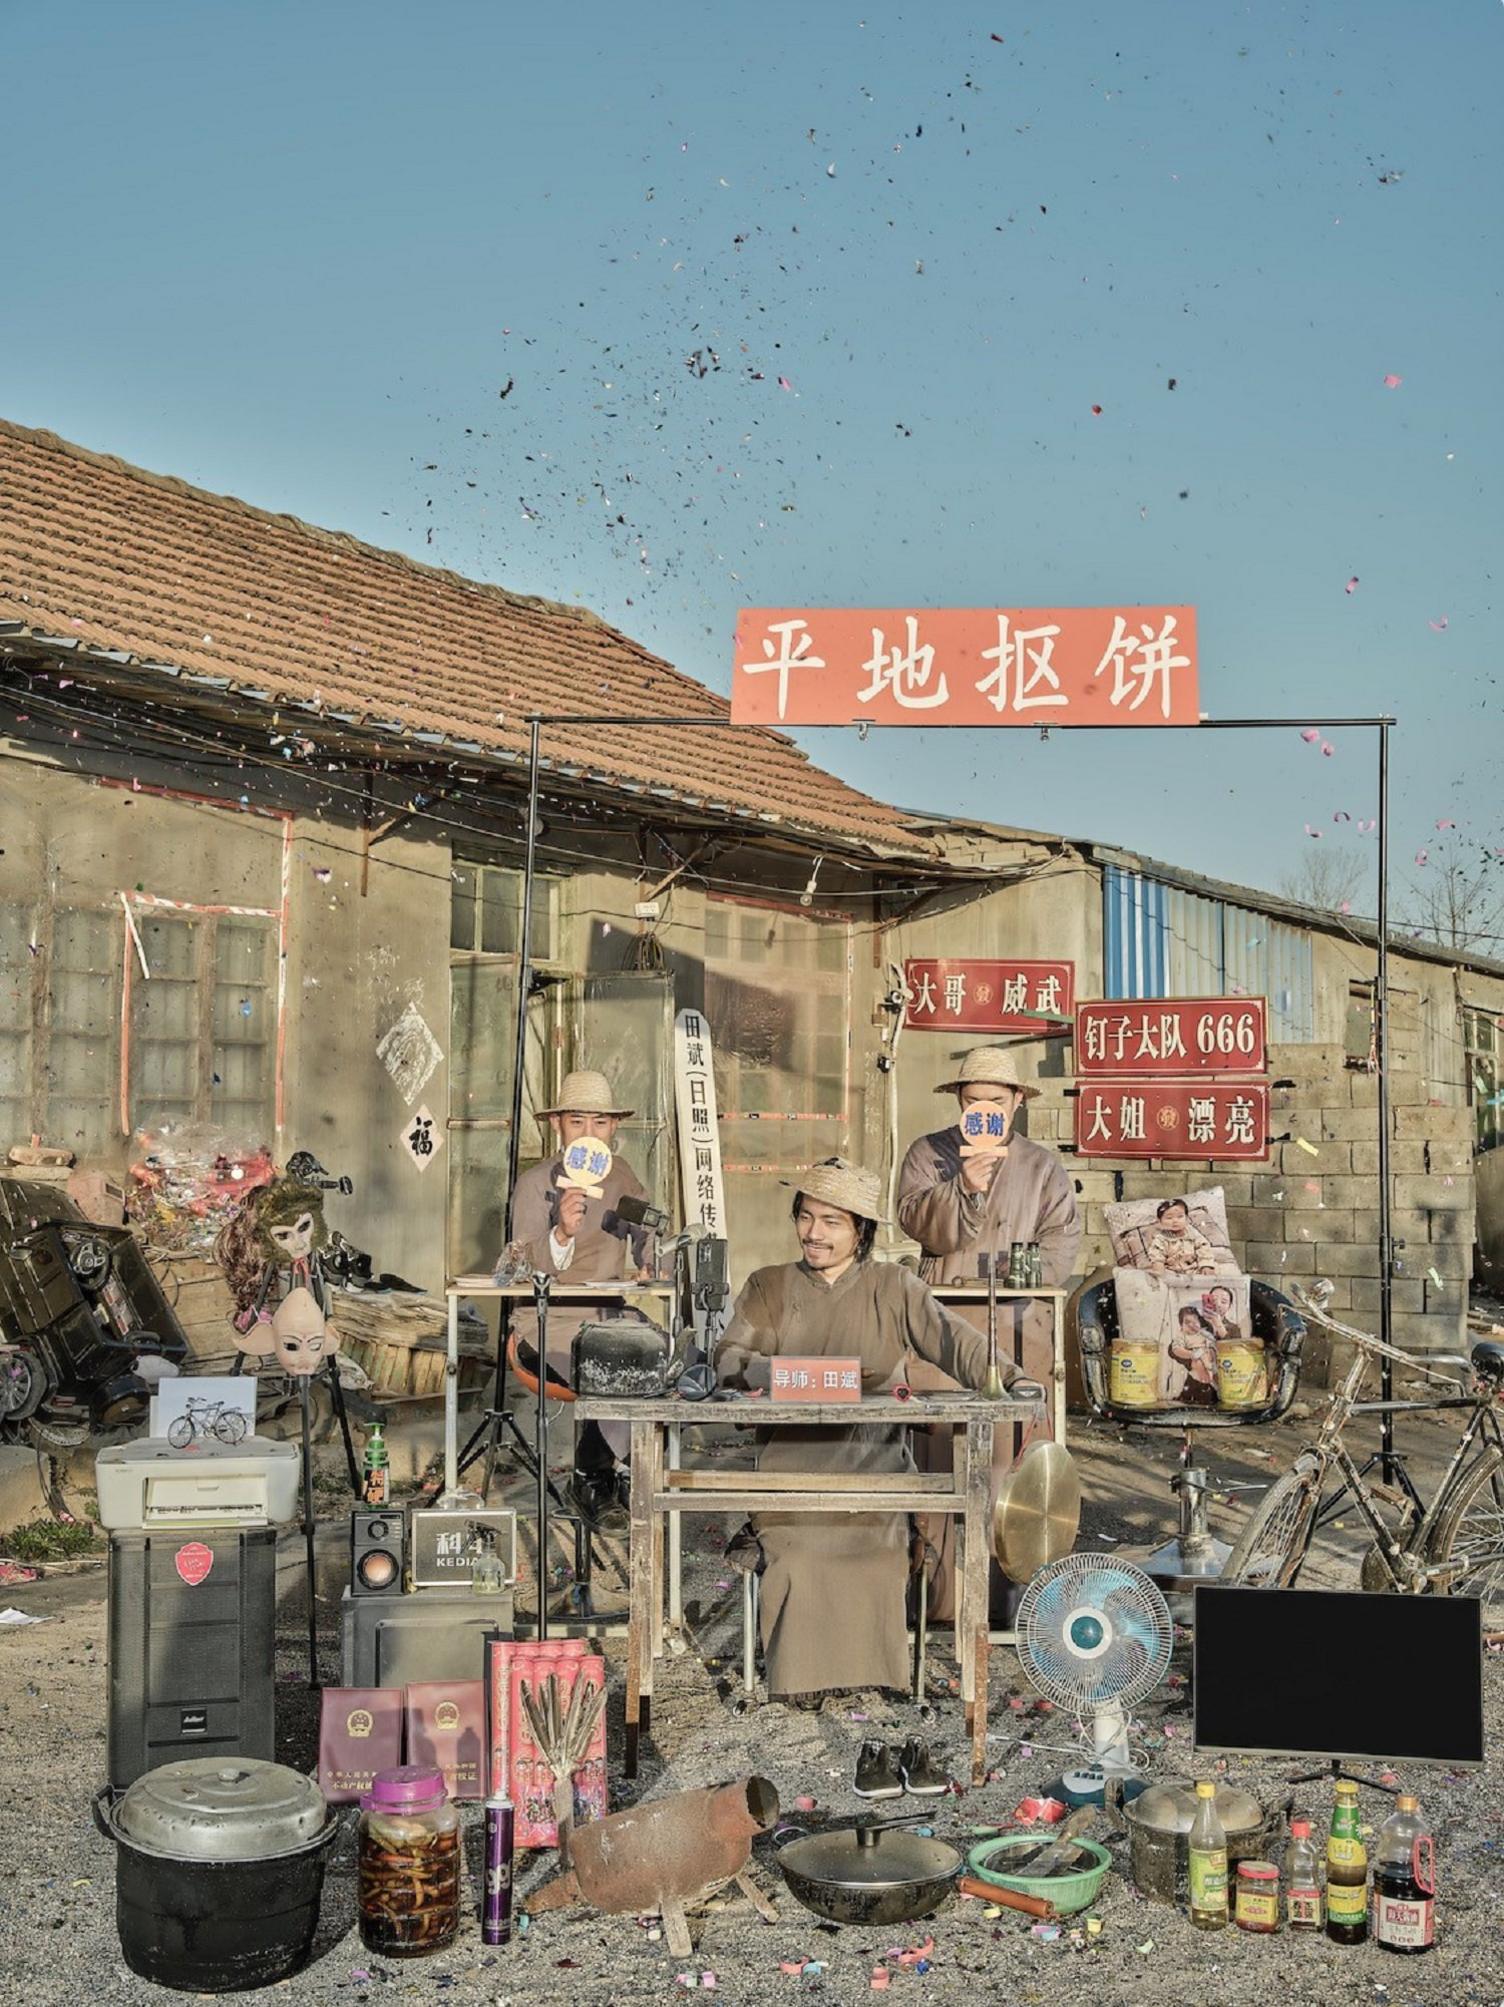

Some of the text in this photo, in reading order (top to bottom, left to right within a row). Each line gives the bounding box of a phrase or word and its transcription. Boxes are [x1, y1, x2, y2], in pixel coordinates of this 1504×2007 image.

[742, 615, 1192, 719] 平地抠饼
[1196, 1013, 1255, 1054] 666
[408, 1115, 433, 1157] 福
[964, 1111, 1006, 1137] 感谢
[565, 1145, 609, 1178] 感谢
